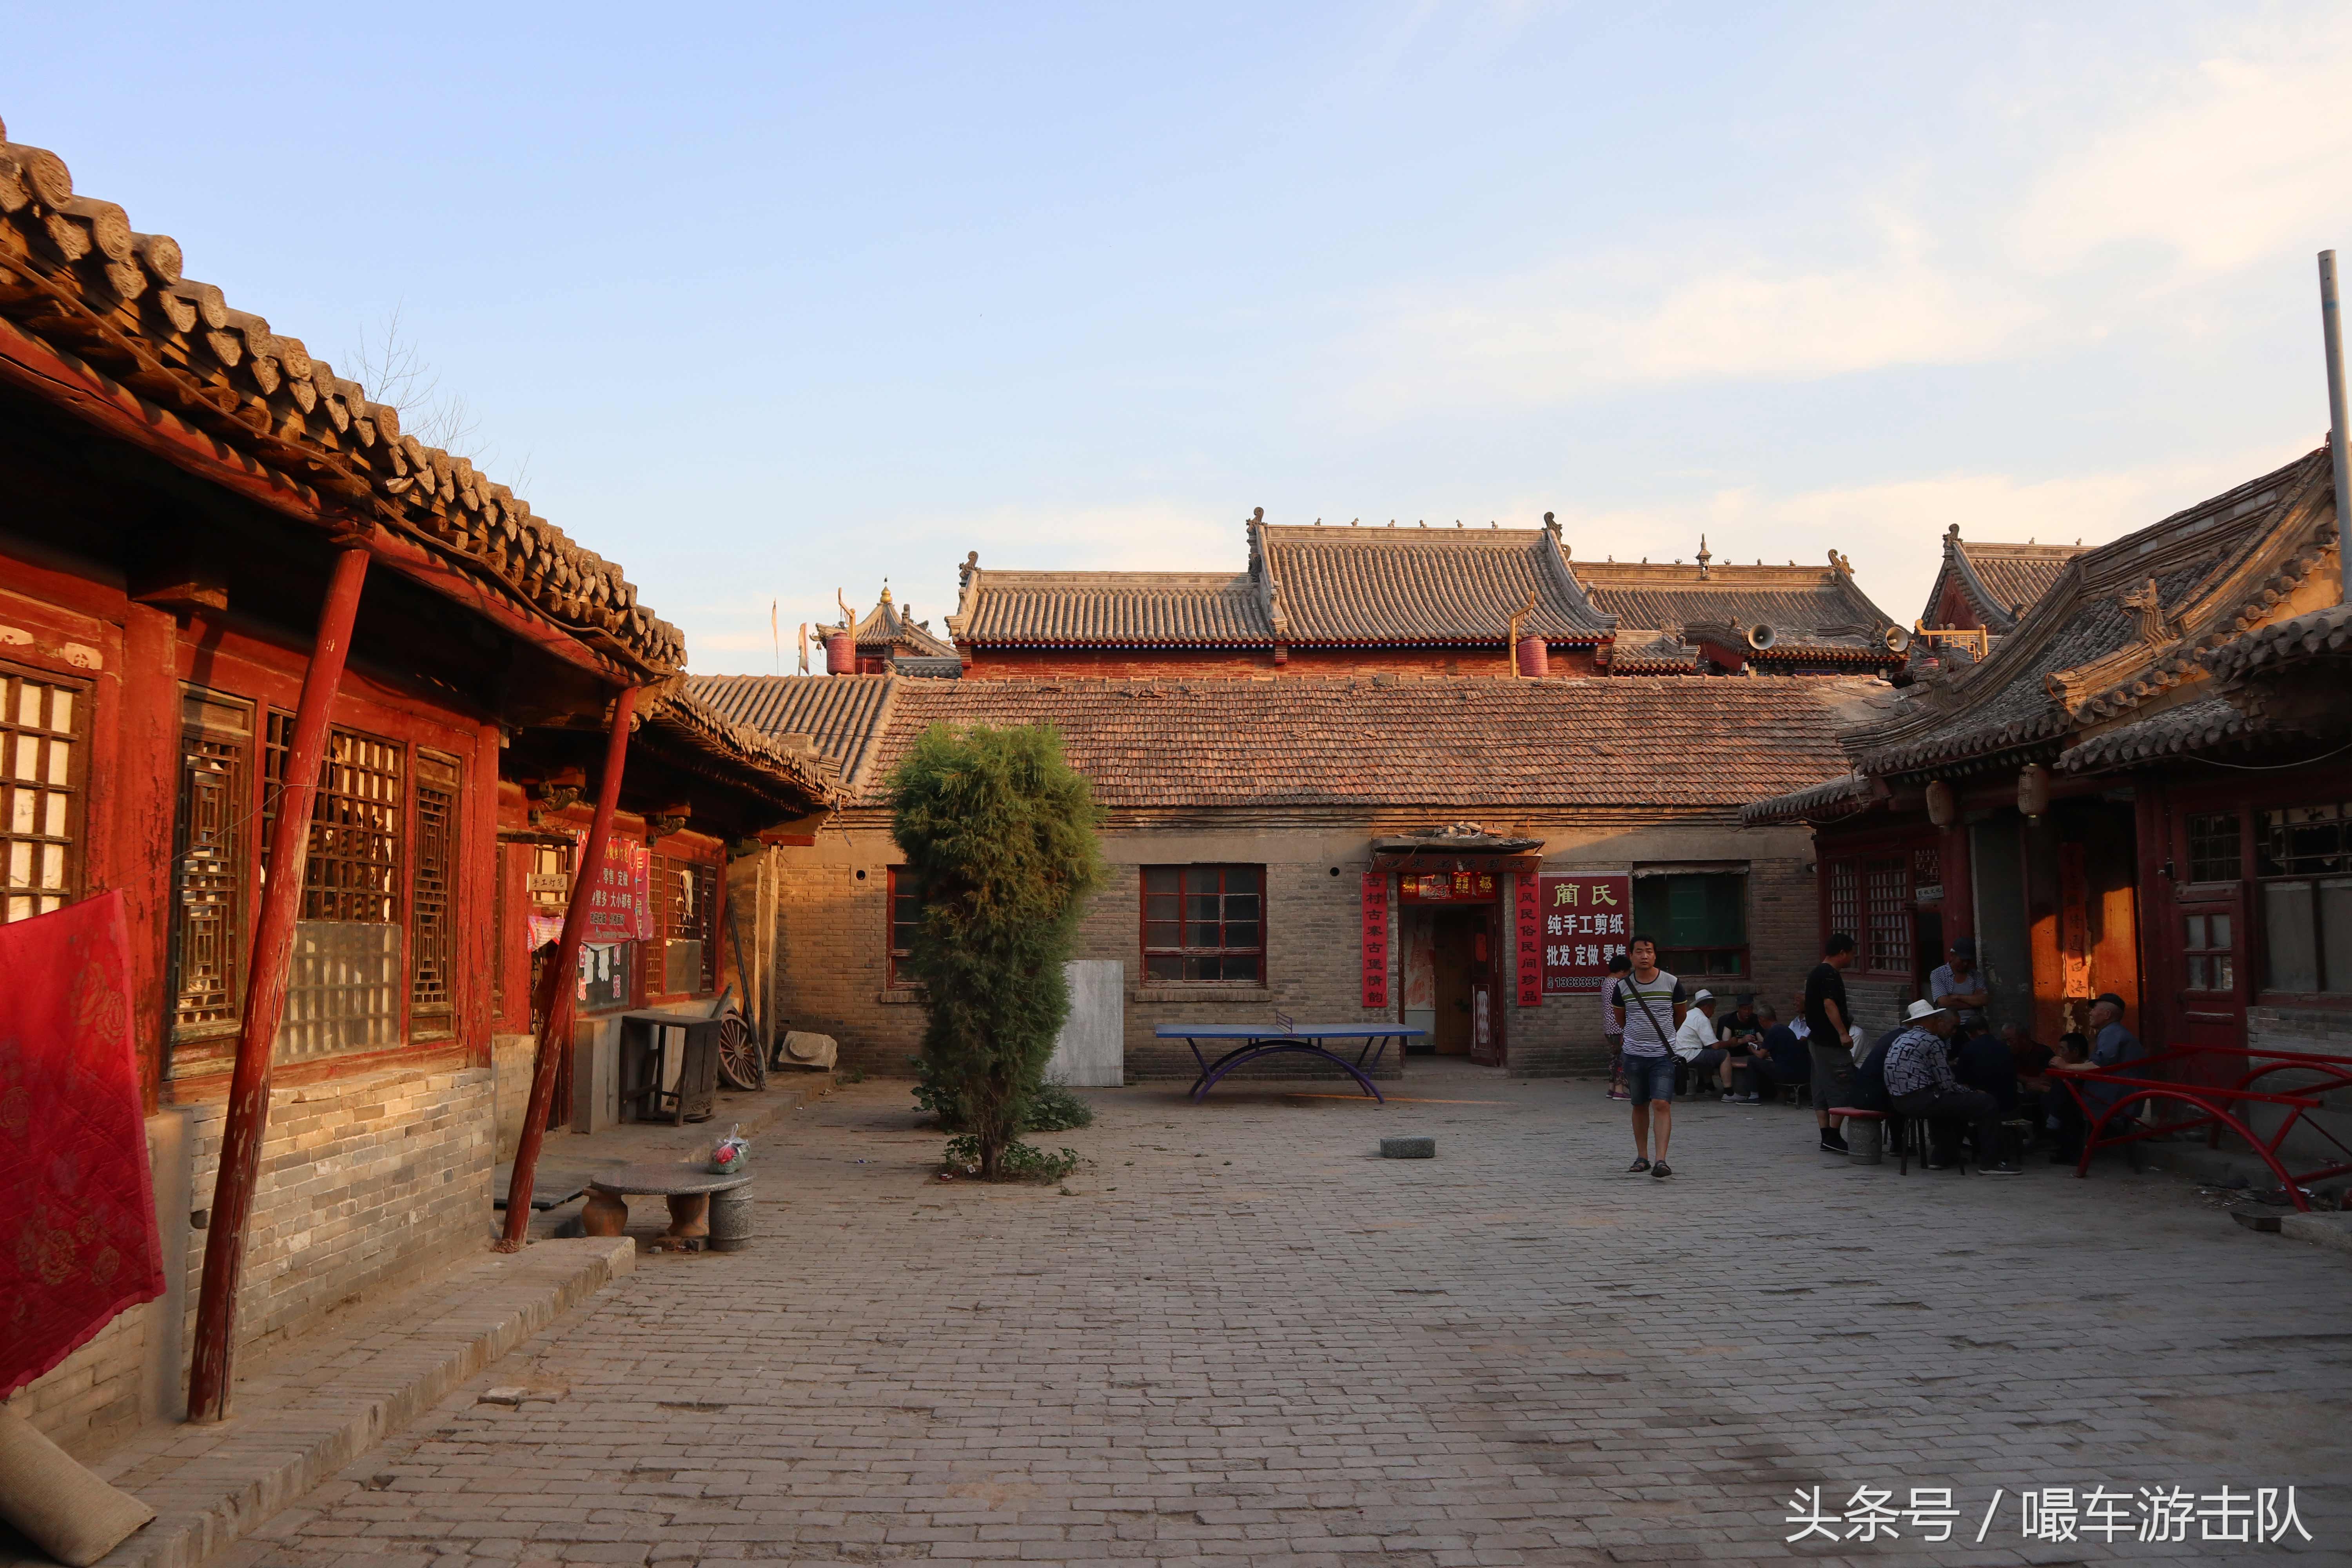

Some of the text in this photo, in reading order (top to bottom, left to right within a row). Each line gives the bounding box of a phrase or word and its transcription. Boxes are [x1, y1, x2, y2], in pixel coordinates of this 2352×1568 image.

[532, 878, 564, 887] 手工灯笼
[610, 891, 632, 909] 大小都有
[1553, 883, 1617, 907] 蔺氏
[1548, 914, 1624, 935] 纯手工剪纸
[1366, 877, 1383, 1003] 古村古寨古堡情韵
[1519, 877, 1537, 1002] 民风民俗民间珍品
[1547, 944, 1570, 966] 批发
[1575, 944, 1599, 966] 定做
[613, 944, 621, 998] 灯笼
